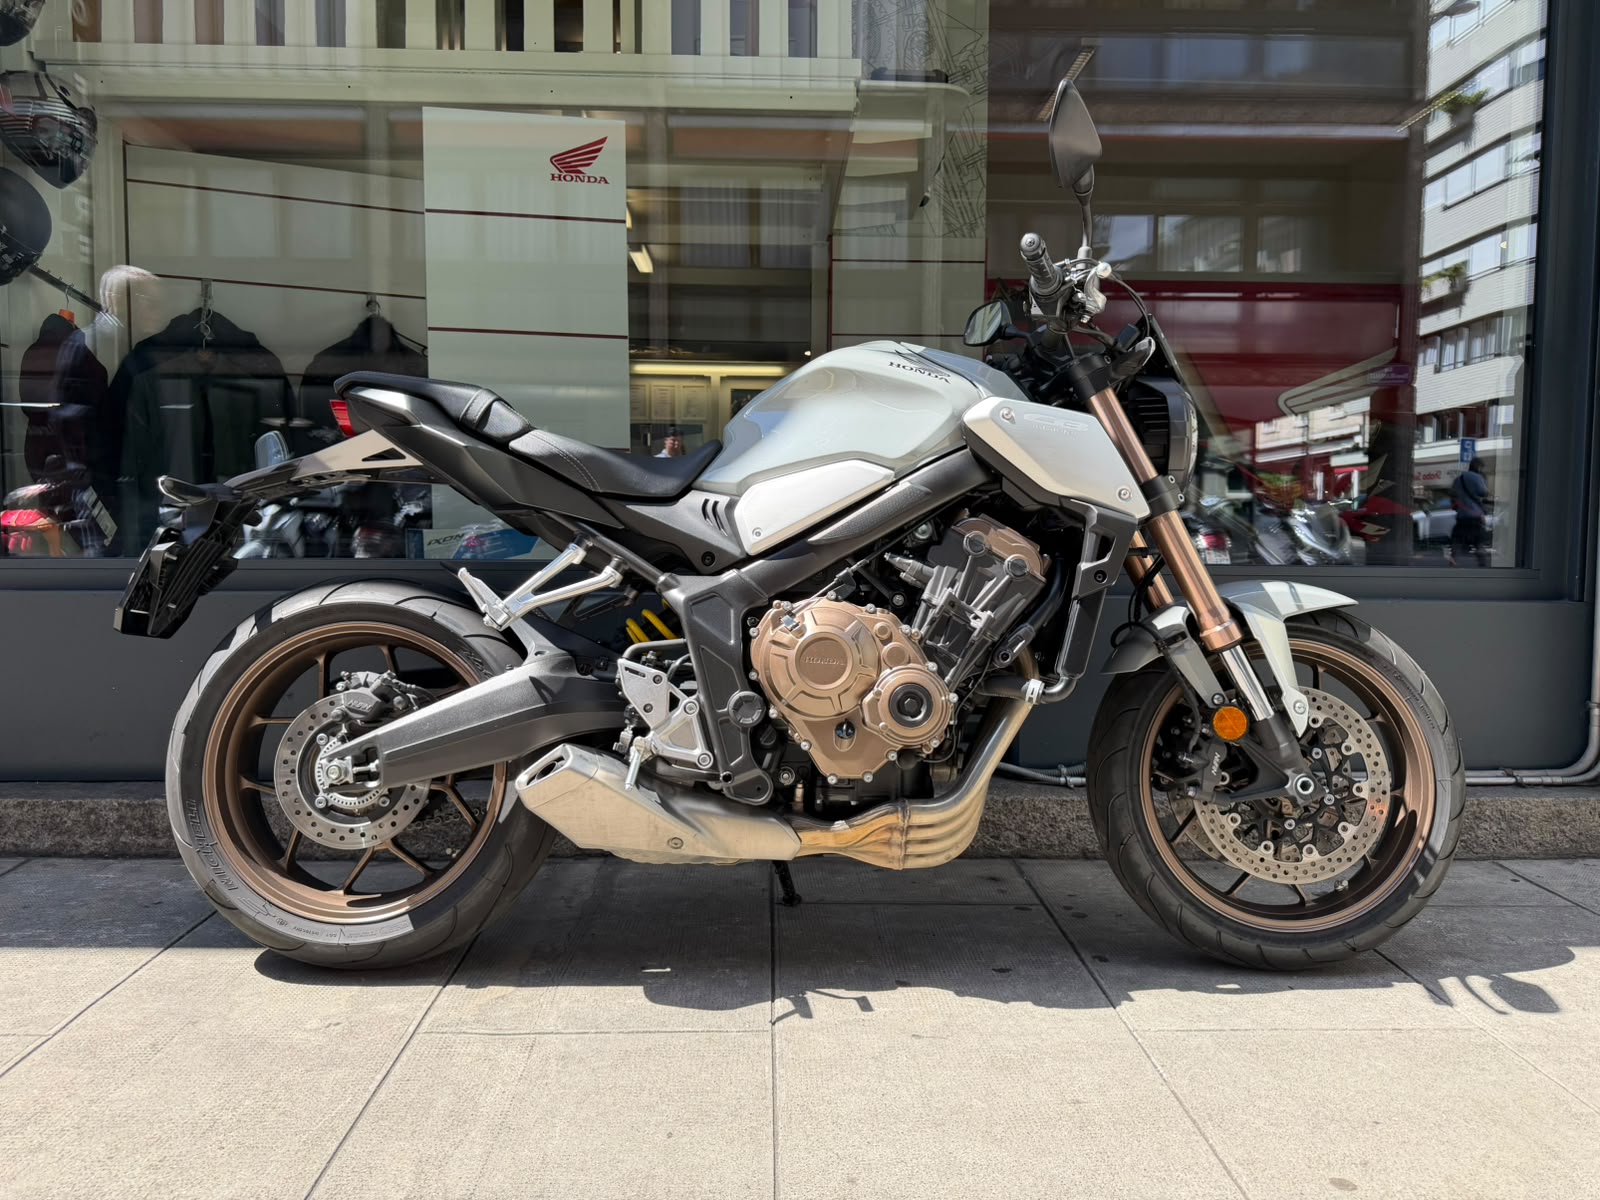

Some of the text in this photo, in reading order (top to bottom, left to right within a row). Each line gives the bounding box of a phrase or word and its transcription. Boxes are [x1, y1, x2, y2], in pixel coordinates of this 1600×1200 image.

[550, 173, 610, 184] HONDA
[888, 361, 950, 384] HONDA
[804, 656, 846, 666] HONDA
